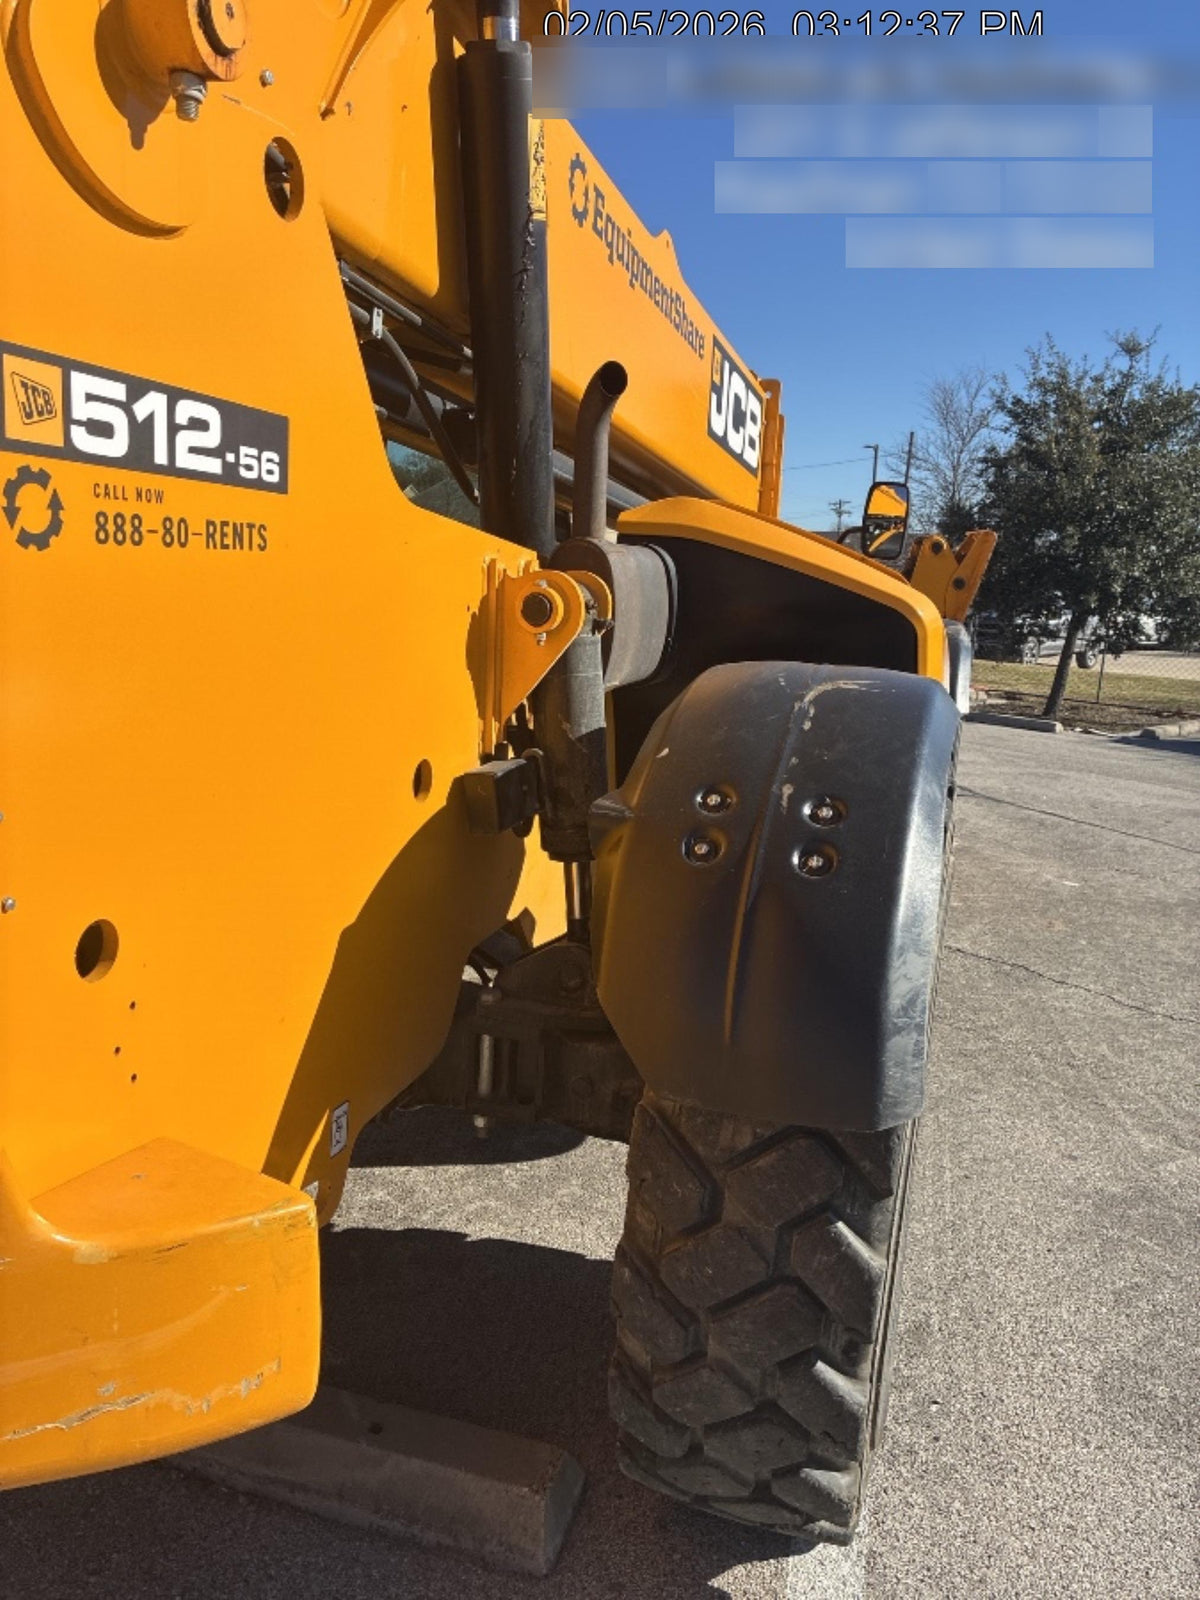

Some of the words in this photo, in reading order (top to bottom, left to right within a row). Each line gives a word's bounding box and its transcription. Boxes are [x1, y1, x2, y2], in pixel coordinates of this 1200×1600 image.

[592, 182, 705, 360] EquipmentShare
[18, 379, 56, 422] JCB
[710, 359, 762, 469] JCB
[92, 482, 129, 502] CALL
[135, 485, 165, 505] NOW
[94, 510, 268, 552] 888-80-RENTS
